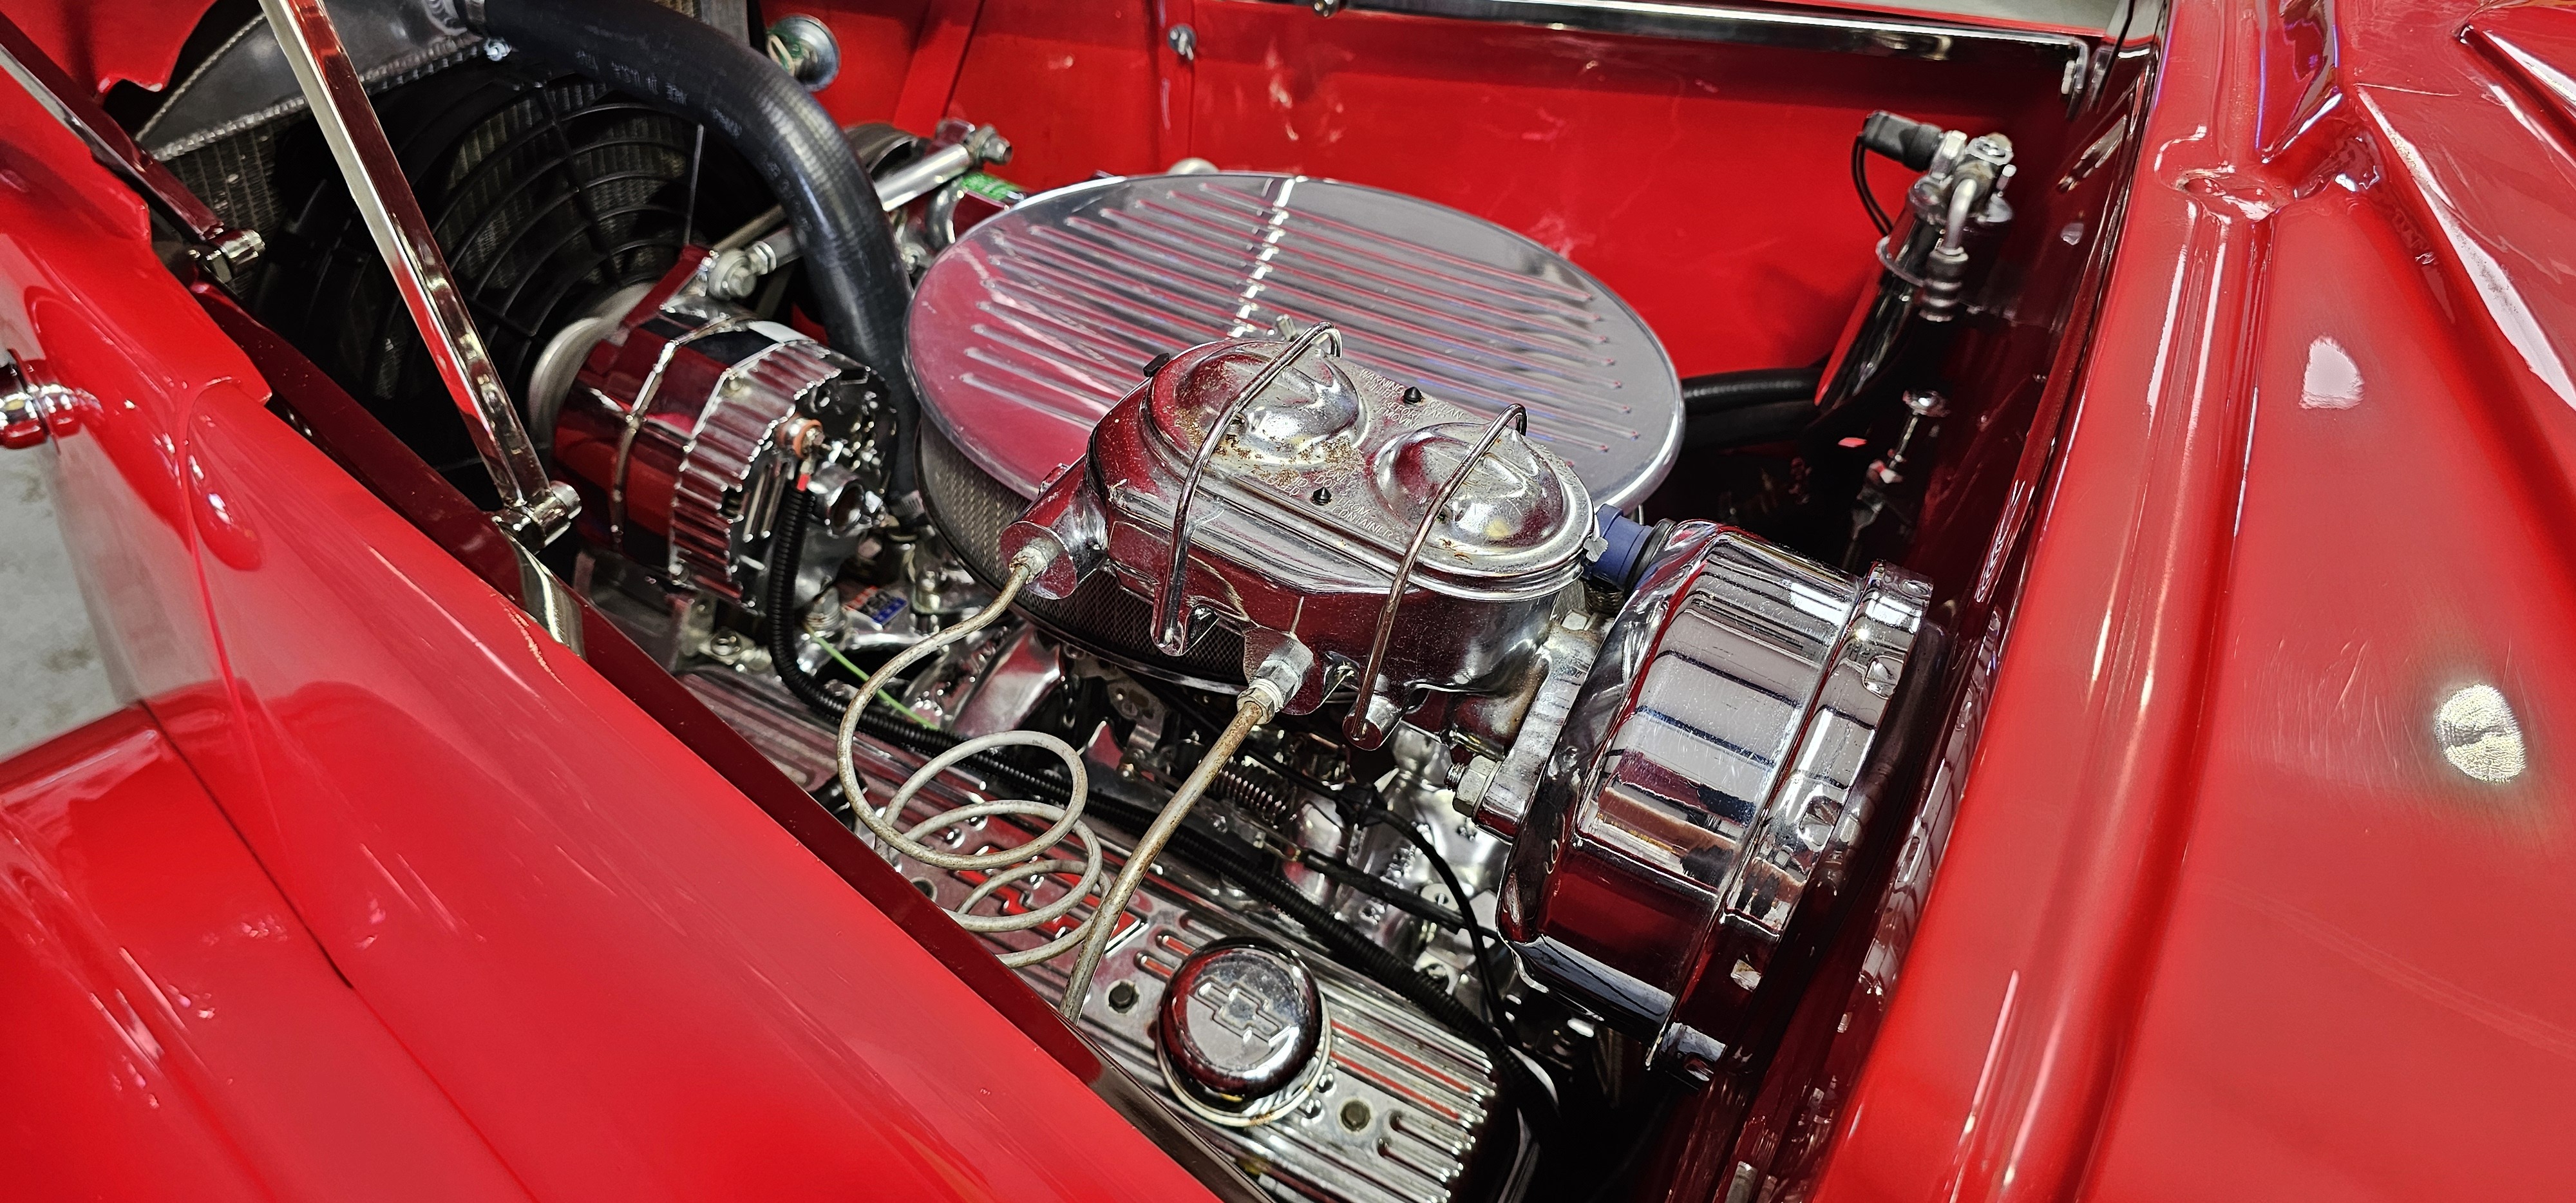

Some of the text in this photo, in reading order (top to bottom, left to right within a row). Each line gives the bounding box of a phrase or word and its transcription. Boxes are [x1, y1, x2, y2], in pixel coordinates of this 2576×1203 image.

[1359, 368, 1464, 420] WARNING CLEAN
[1381, 399, 1423, 422] BEFORE
[1421, 406, 1446, 419] CAP
[1314, 475, 1338, 491] DOT
[1337, 497, 1369, 516] FROM
